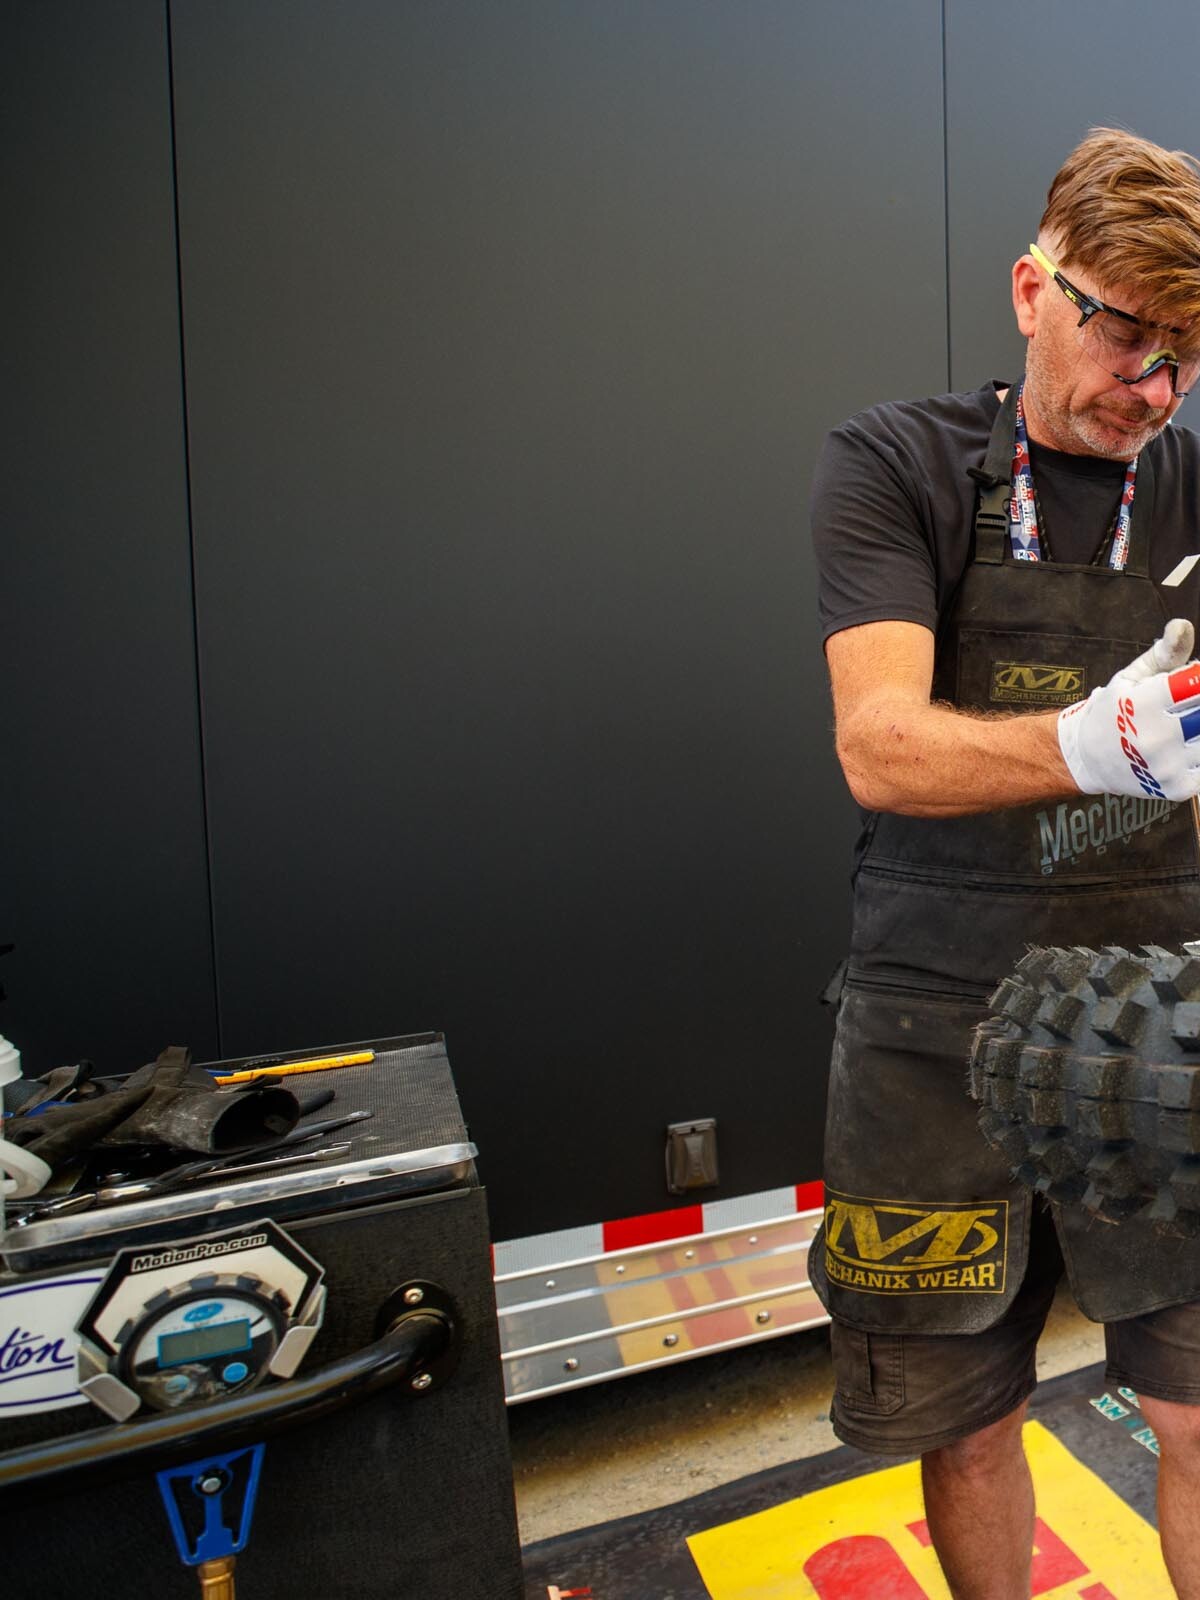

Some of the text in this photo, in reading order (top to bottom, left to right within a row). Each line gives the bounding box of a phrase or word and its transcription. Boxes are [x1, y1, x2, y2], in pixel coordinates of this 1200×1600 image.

[1018, 475, 1034, 534] MOTOCROSS
[992, 686, 1079, 703] MECHANIX WEAR
[1117, 697, 1167, 799] 100%
[131, 1234, 267, 1272] MotionPro.com
[916, 1263, 995, 1288] WEAR
[0, 1326, 75, 1374] tion
